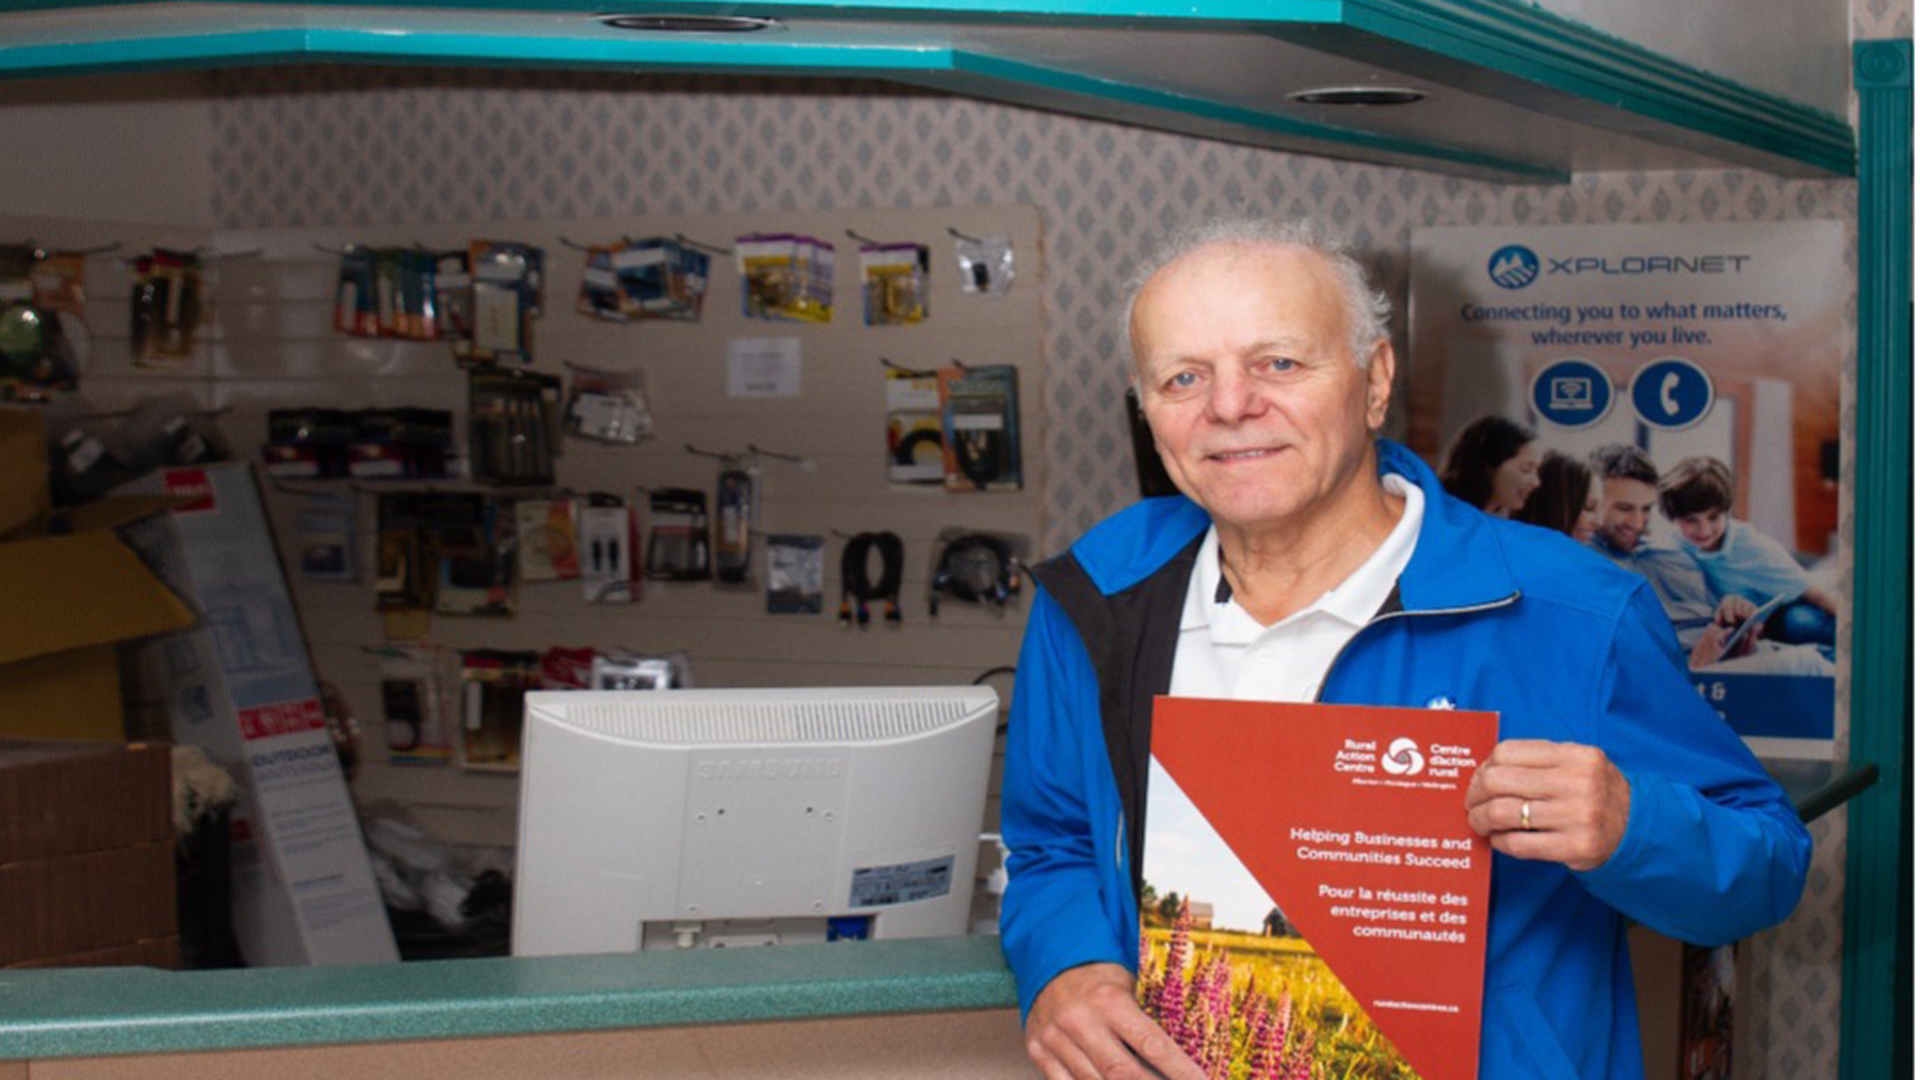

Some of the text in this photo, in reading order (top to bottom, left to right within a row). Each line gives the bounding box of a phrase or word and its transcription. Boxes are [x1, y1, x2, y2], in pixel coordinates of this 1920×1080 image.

[1548, 255, 1750, 275] XPLORNET
[1461, 303, 1787, 323] Connecting you to what matters,
[1532, 328, 1711, 349] wherever you live.
[1344, 739, 1376, 751] Rural
[1430, 744, 1471, 756] Centre
[1336, 750, 1375, 762] Action
[698, 759, 841, 780] SAMSUNG
[1334, 761, 1375, 773] Centre
[1429, 767, 1458, 777] rural
[1290, 828, 1472, 850] Helping Businesses and
[1296, 847, 1470, 869] Communities Succeed
[1318, 884, 1468, 906] Pour la réussite des
[1330, 905, 1467, 924] entreprises et des
[1353, 925, 1466, 943] communautés
